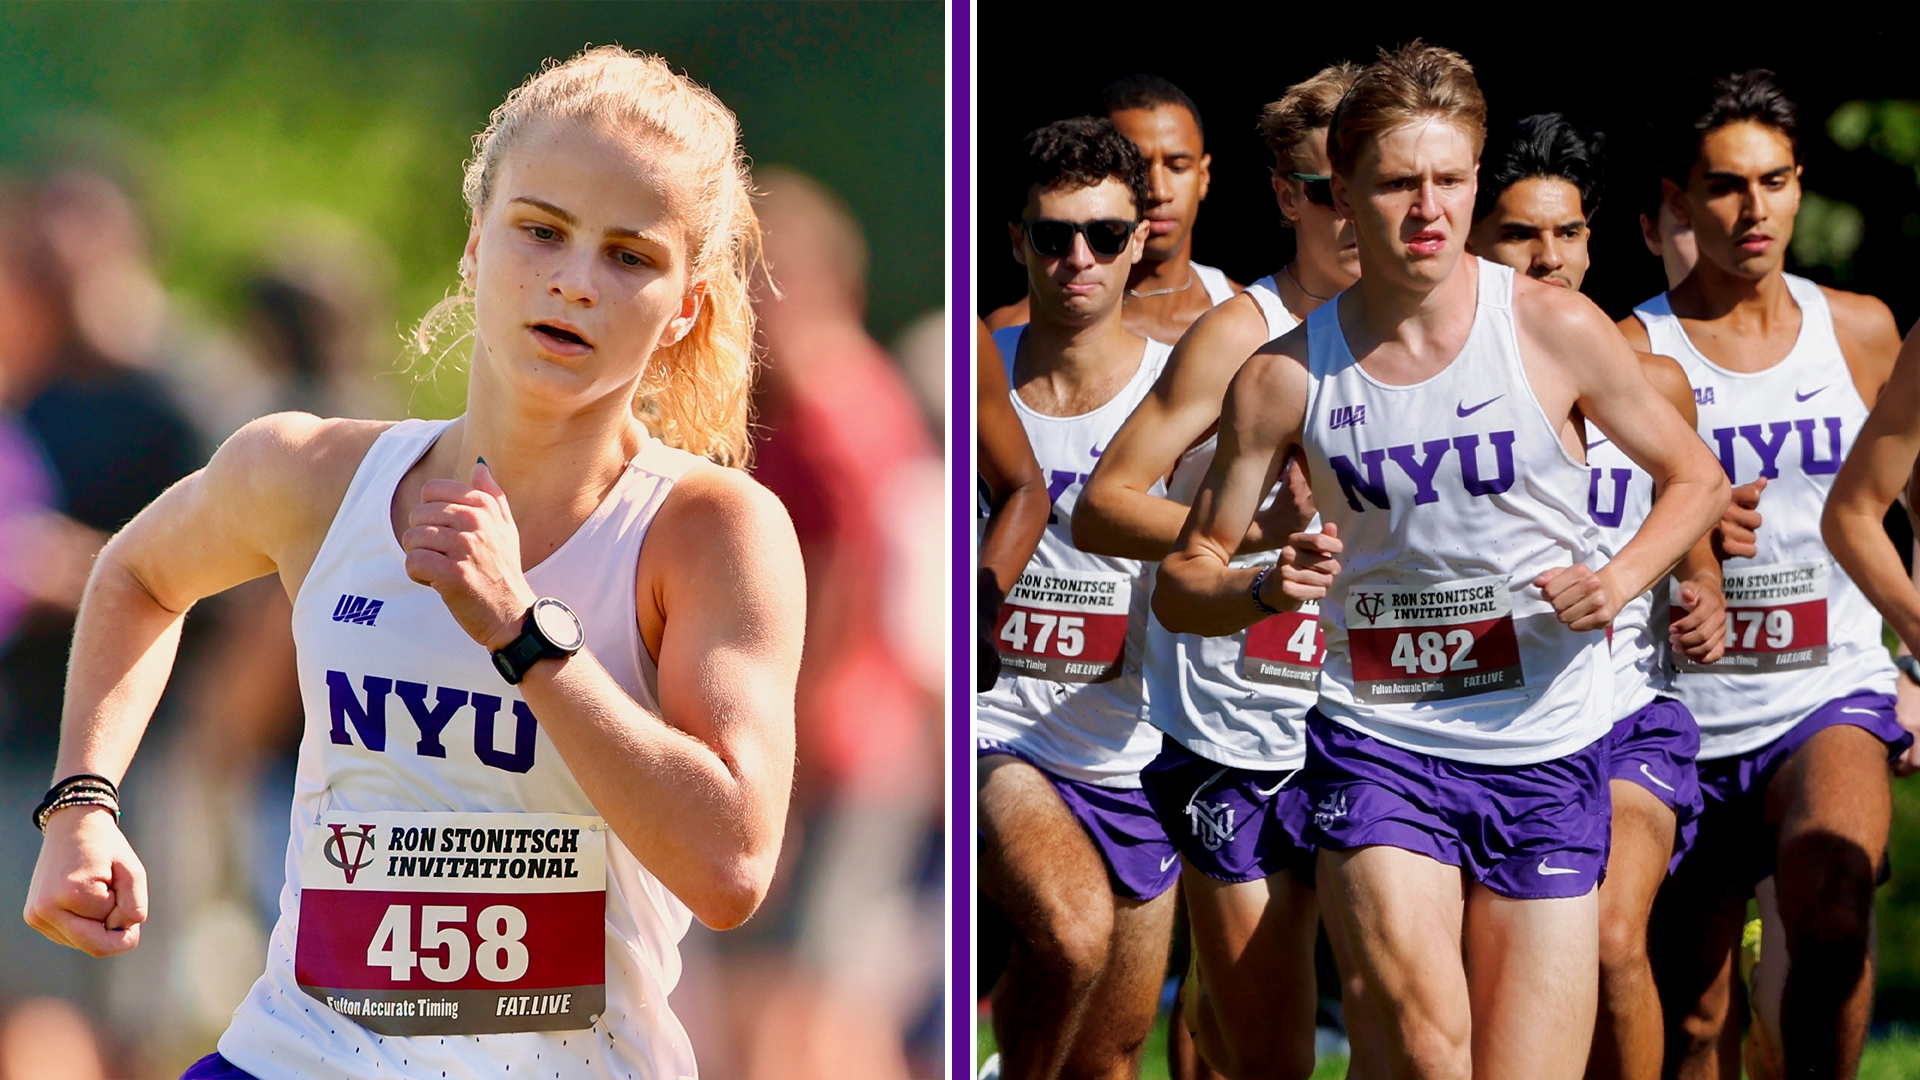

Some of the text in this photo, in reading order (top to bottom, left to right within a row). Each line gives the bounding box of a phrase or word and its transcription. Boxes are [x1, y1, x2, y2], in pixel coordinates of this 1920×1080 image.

[1694, 387, 1715, 405] AA
[1329, 405, 1367, 430] UAA
[1329, 430, 1515, 513] NYU
[1043, 577, 1117, 595] STONITSCH
[1747, 568, 1814, 588] STONITSCH
[1014, 587, 1115, 606] INVITATIONAL
[1391, 585, 1495, 607] RON STONITSCH
[1723, 582, 1815, 600] NVITATIONAL
[332, 593, 385, 627] UAA
[1393, 600, 1497, 620] INVITATIONAL
[1000, 610, 1086, 657] 475
[1390, 628, 1479, 675] 482
[1025, 659, 1047, 673] Timing
[1064, 662, 1106, 676] FAT.LIVE
[1260, 663, 1282, 677] Fulton
[1281, 667, 1311, 680] Accurate
[1371, 681, 1444, 695] Fulton Accurate Timing
[1463, 670, 1505, 688] FAT.LIVE
[326, 670, 538, 774] NYU
[387, 827, 580, 853] RON STONITSCH
[387, 856, 579, 879] INVITATIONAL
[366, 904, 529, 983] 458
[326, 996, 459, 1019] Fulton Accurate Timing
[496, 993, 573, 1016] FAT.LIVE
